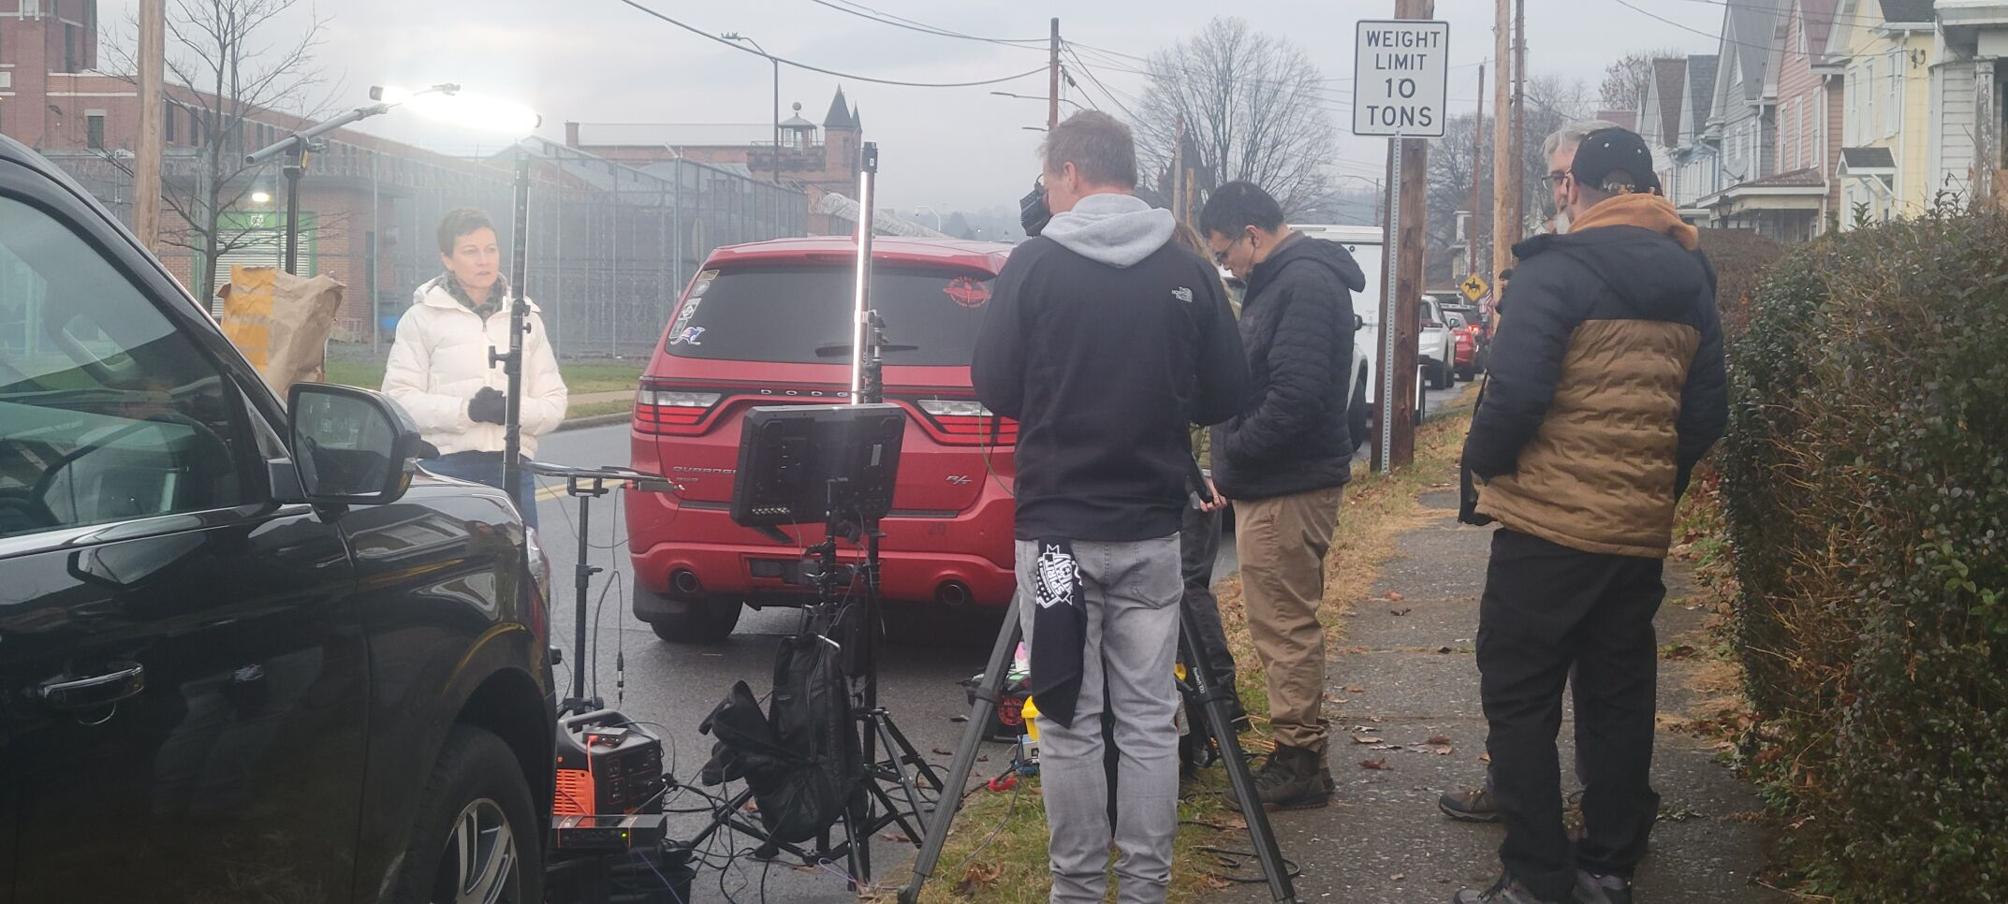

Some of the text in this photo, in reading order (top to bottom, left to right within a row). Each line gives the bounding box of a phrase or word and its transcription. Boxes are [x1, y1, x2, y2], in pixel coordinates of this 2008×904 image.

[1366, 30, 1441, 48] WEIGHT
[1375, 53, 1428, 70] LIMIT
[1385, 77, 1416, 98] 10
[1366, 105, 1433, 127] TONS
[760, 388, 849, 399] DODG
[1045, 559, 1065, 596] SPIRIT
